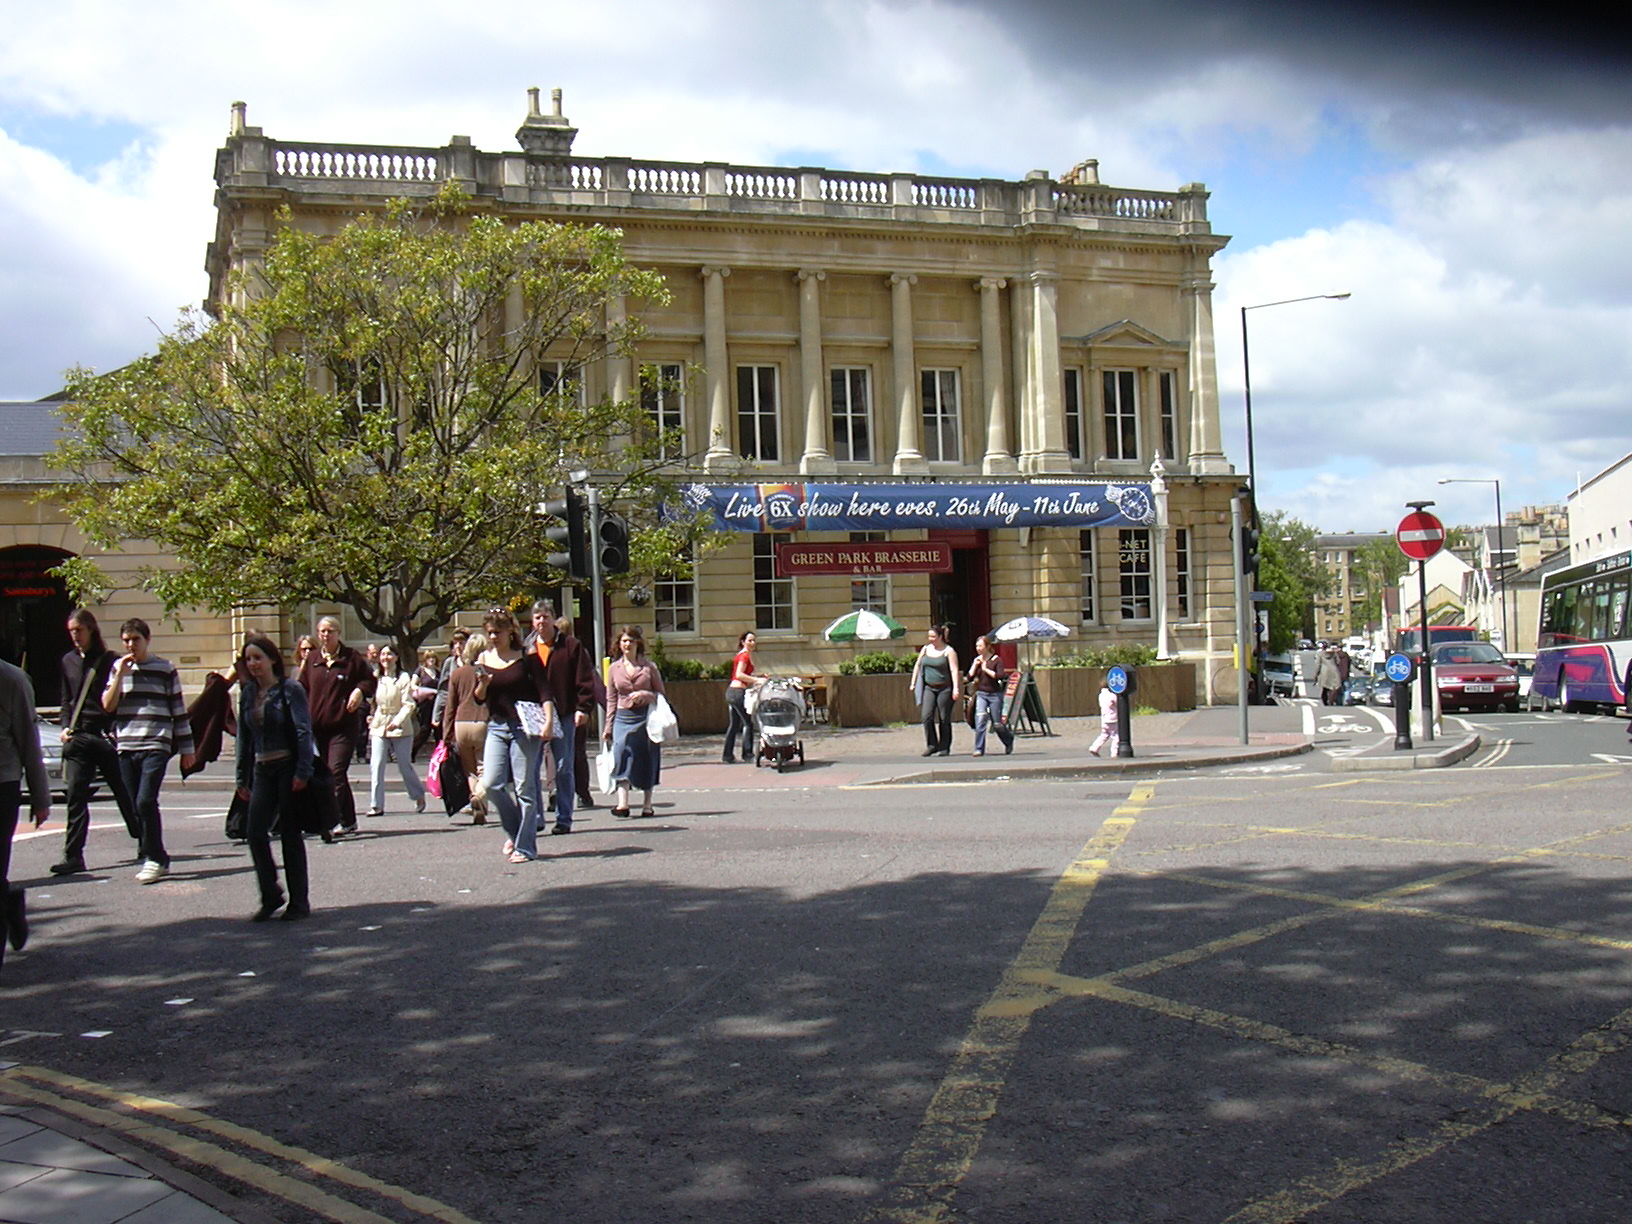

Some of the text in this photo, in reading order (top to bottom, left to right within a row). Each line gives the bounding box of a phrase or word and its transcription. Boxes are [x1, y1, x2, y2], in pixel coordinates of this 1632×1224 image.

[724, 492, 765, 518] Live
[770, 500, 794, 518] 6X
[798, 492, 844, 517] show
[847, 493, 892, 517] here
[895, 500, 940, 518] eves.
[945, 497, 981, 516] 26th
[983, 492, 1020, 525] May
[1033, 496, 1060, 515] 11th
[1063, 492, 1100, 515] June
[791, 550, 941, 565] GREEN PARK BRASSERIE
[852, 564, 882, 573] & BAR
